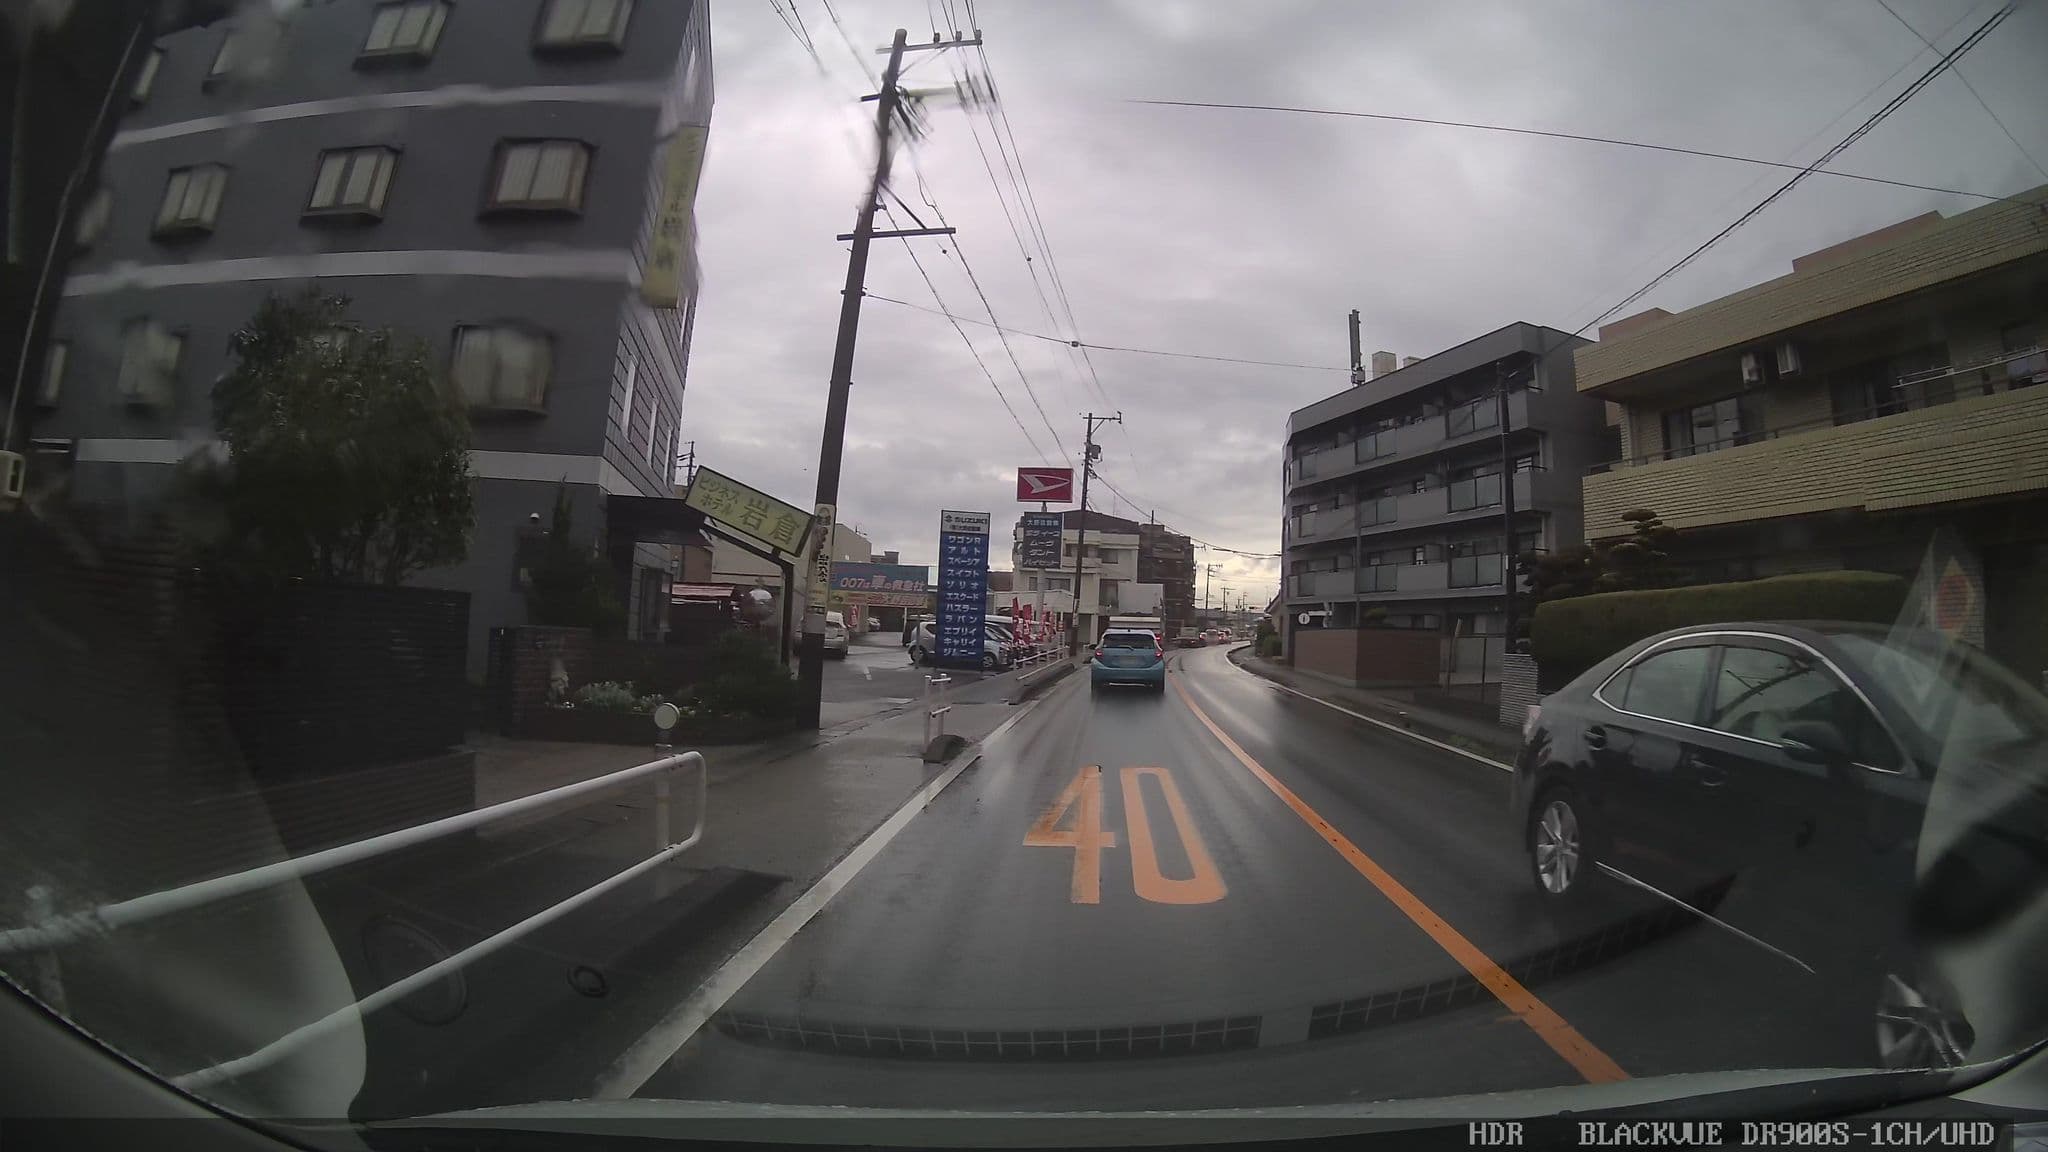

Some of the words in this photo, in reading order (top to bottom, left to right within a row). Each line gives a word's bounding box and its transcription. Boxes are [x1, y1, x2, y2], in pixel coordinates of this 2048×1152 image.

[698, 475, 740, 504] ビジネス
[700, 494, 735, 515] ホテル
[740, 497, 801, 545] 岩倉
[954, 516, 988, 525] SUZUKI
[948, 535, 981, 544] ワゴンR
[946, 603, 978, 612] ハスラー
[1022, 765, 1228, 905] 40
